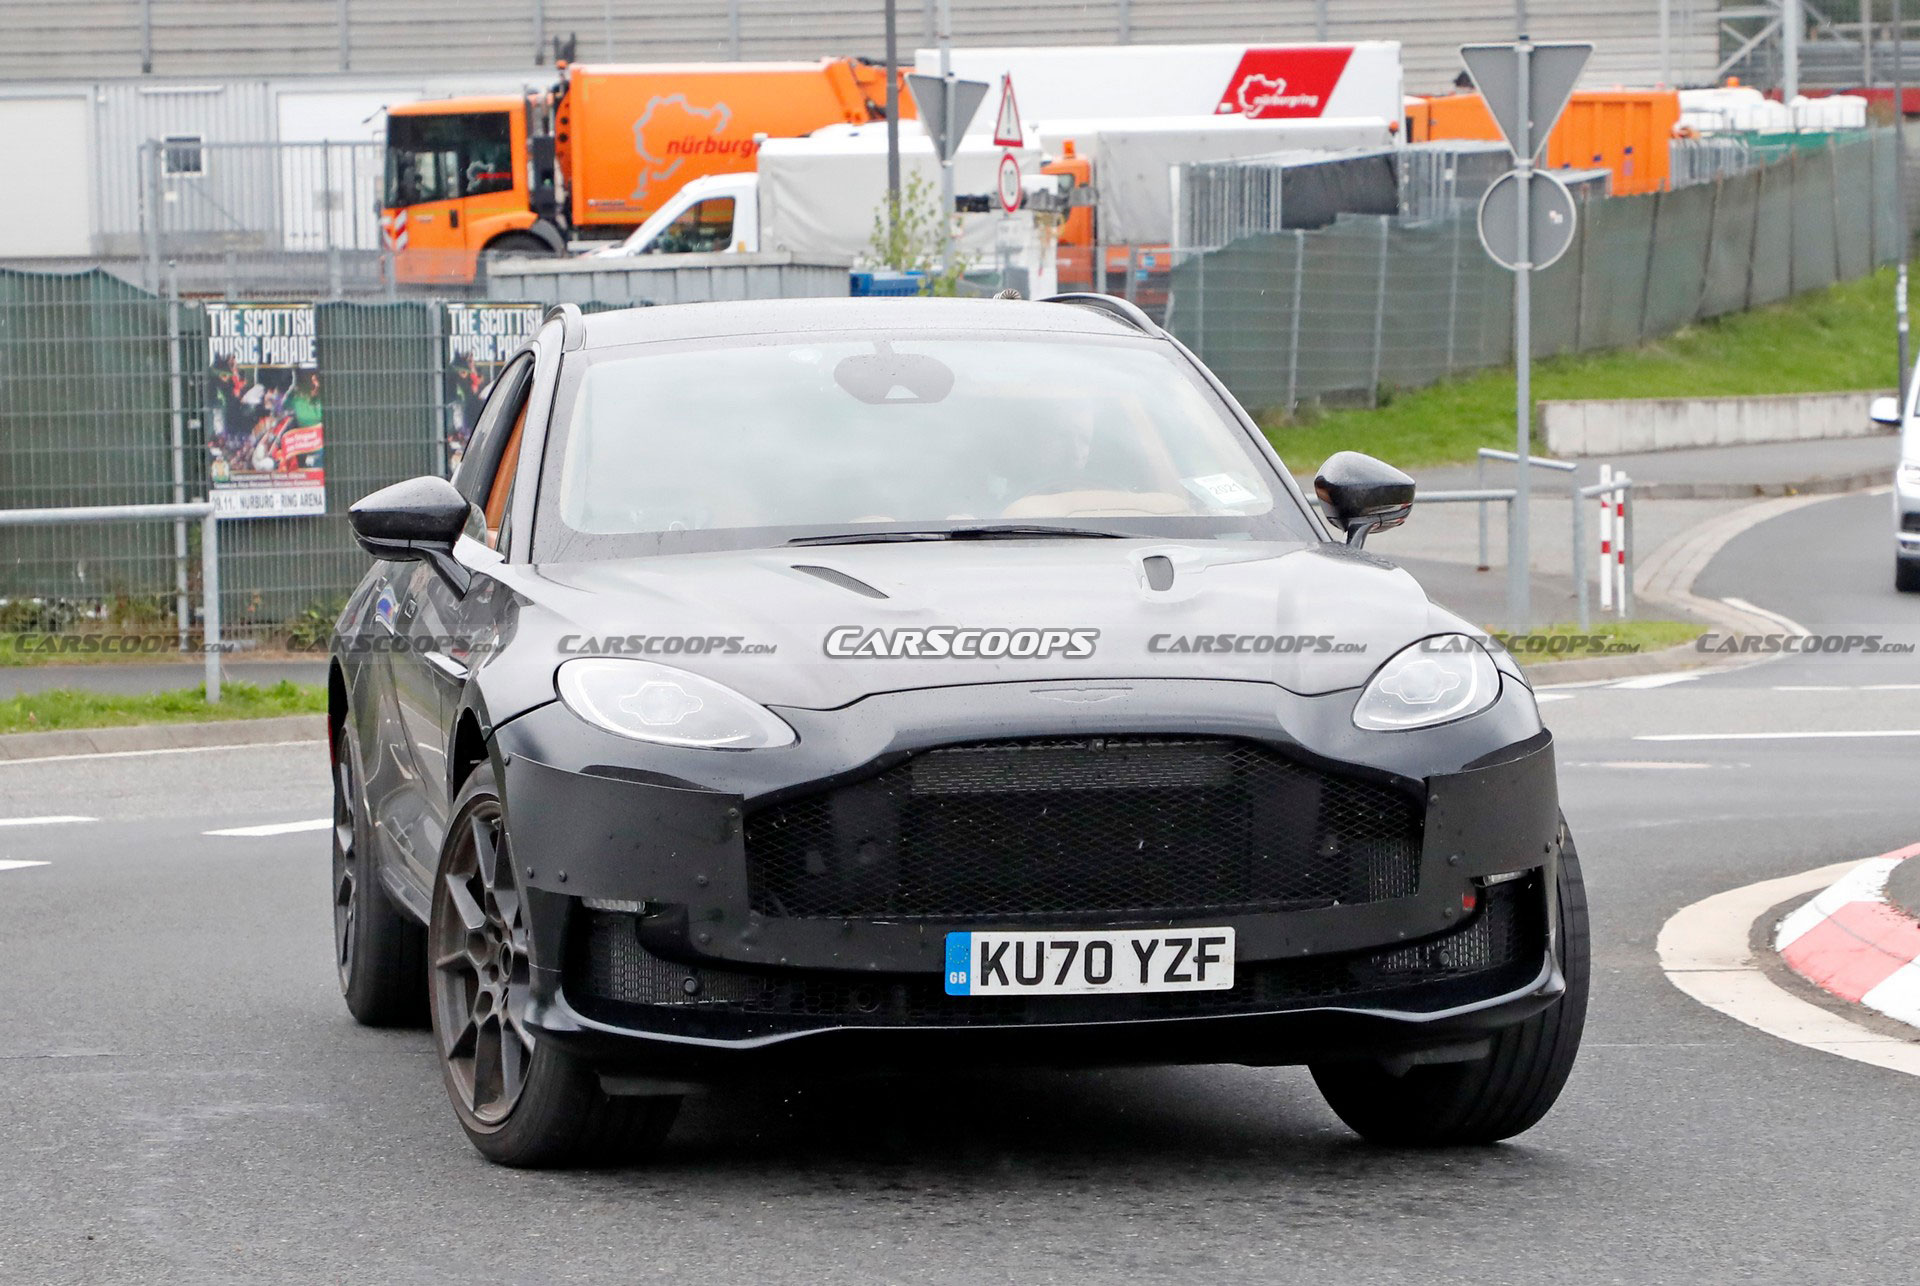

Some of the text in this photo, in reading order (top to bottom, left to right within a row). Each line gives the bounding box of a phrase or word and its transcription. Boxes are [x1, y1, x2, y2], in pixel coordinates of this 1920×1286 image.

[206, 308, 315, 337] THE SCOTTISH
[447, 309, 477, 335] THE
[208, 336, 317, 366] MUSIC PARADE
[300, 491, 323, 507] ARENA
[980, 937, 1226, 986] KU70 YZF
[949, 971, 967, 984] GB
